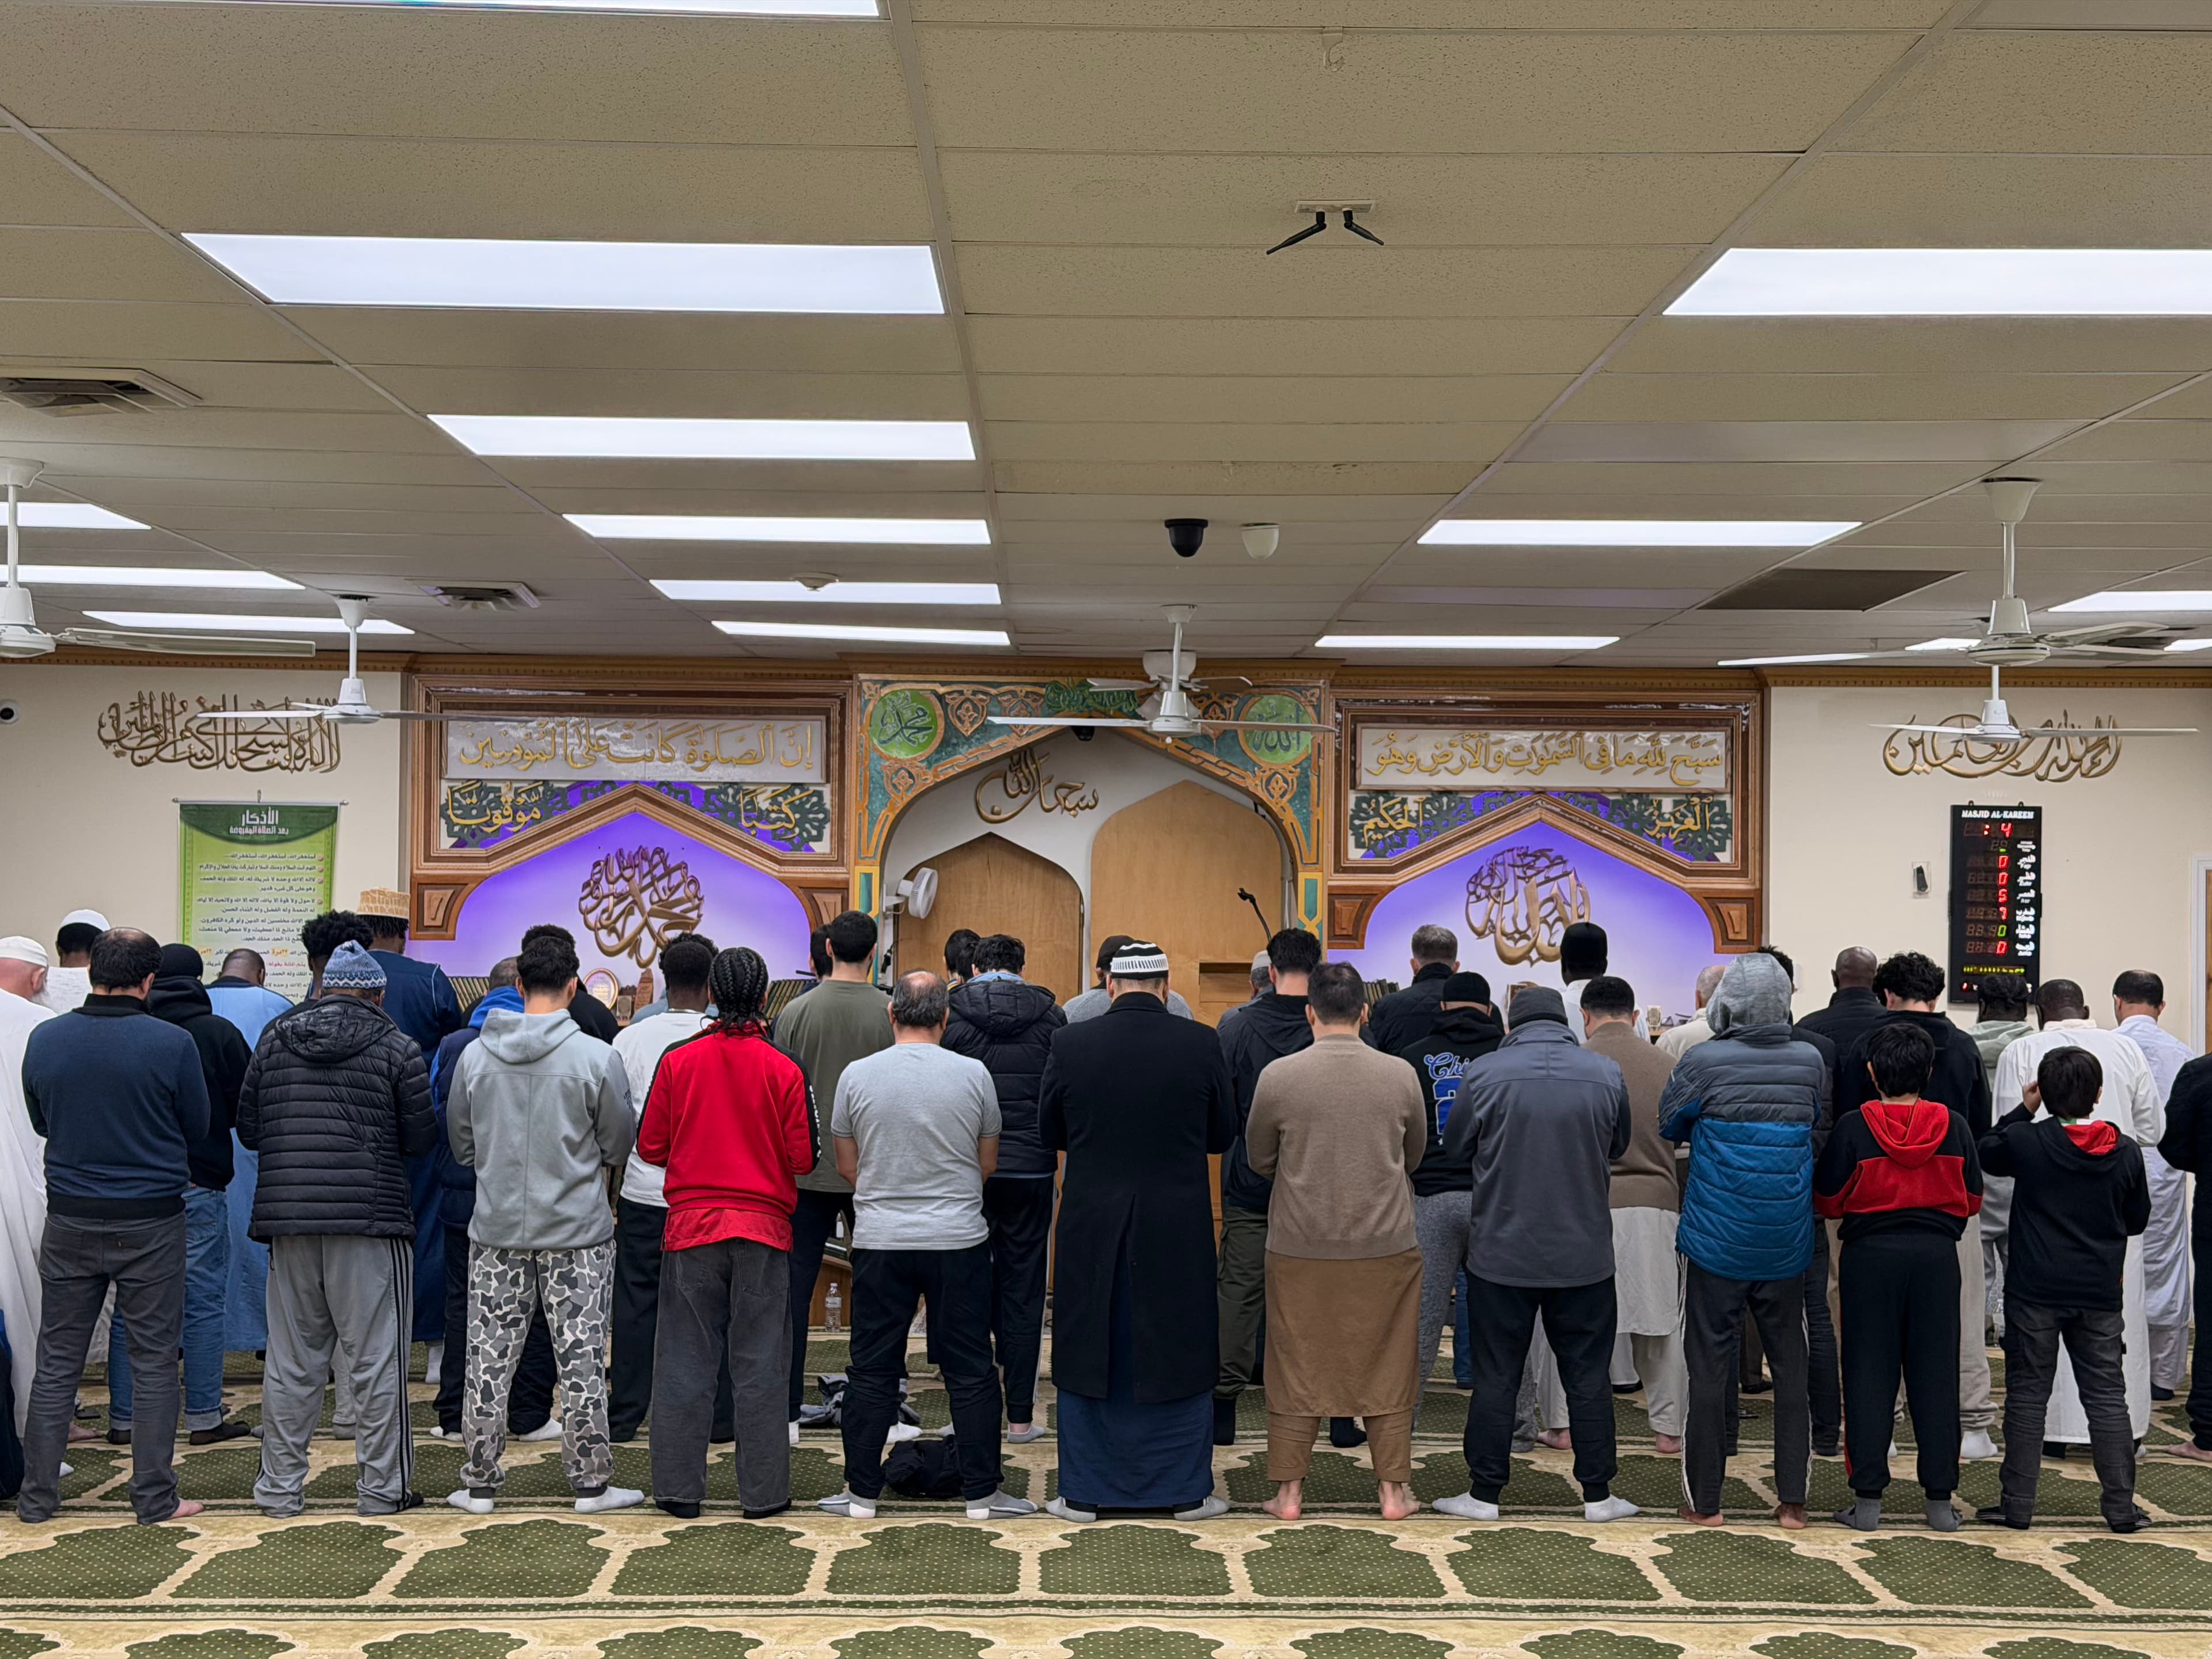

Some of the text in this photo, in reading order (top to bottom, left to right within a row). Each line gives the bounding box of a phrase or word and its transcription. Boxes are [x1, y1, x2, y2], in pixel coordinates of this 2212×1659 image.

[975, 749, 1099, 824] سبحان
[242, 806, 279, 826] الأذكار
[1961, 810, 2035, 819] MASJID AL-KAREEM
[229, 825, 257, 835] المفروضة
[257, 825, 276, 835] الصلاة
[1997, 924, 2008, 937] 0
